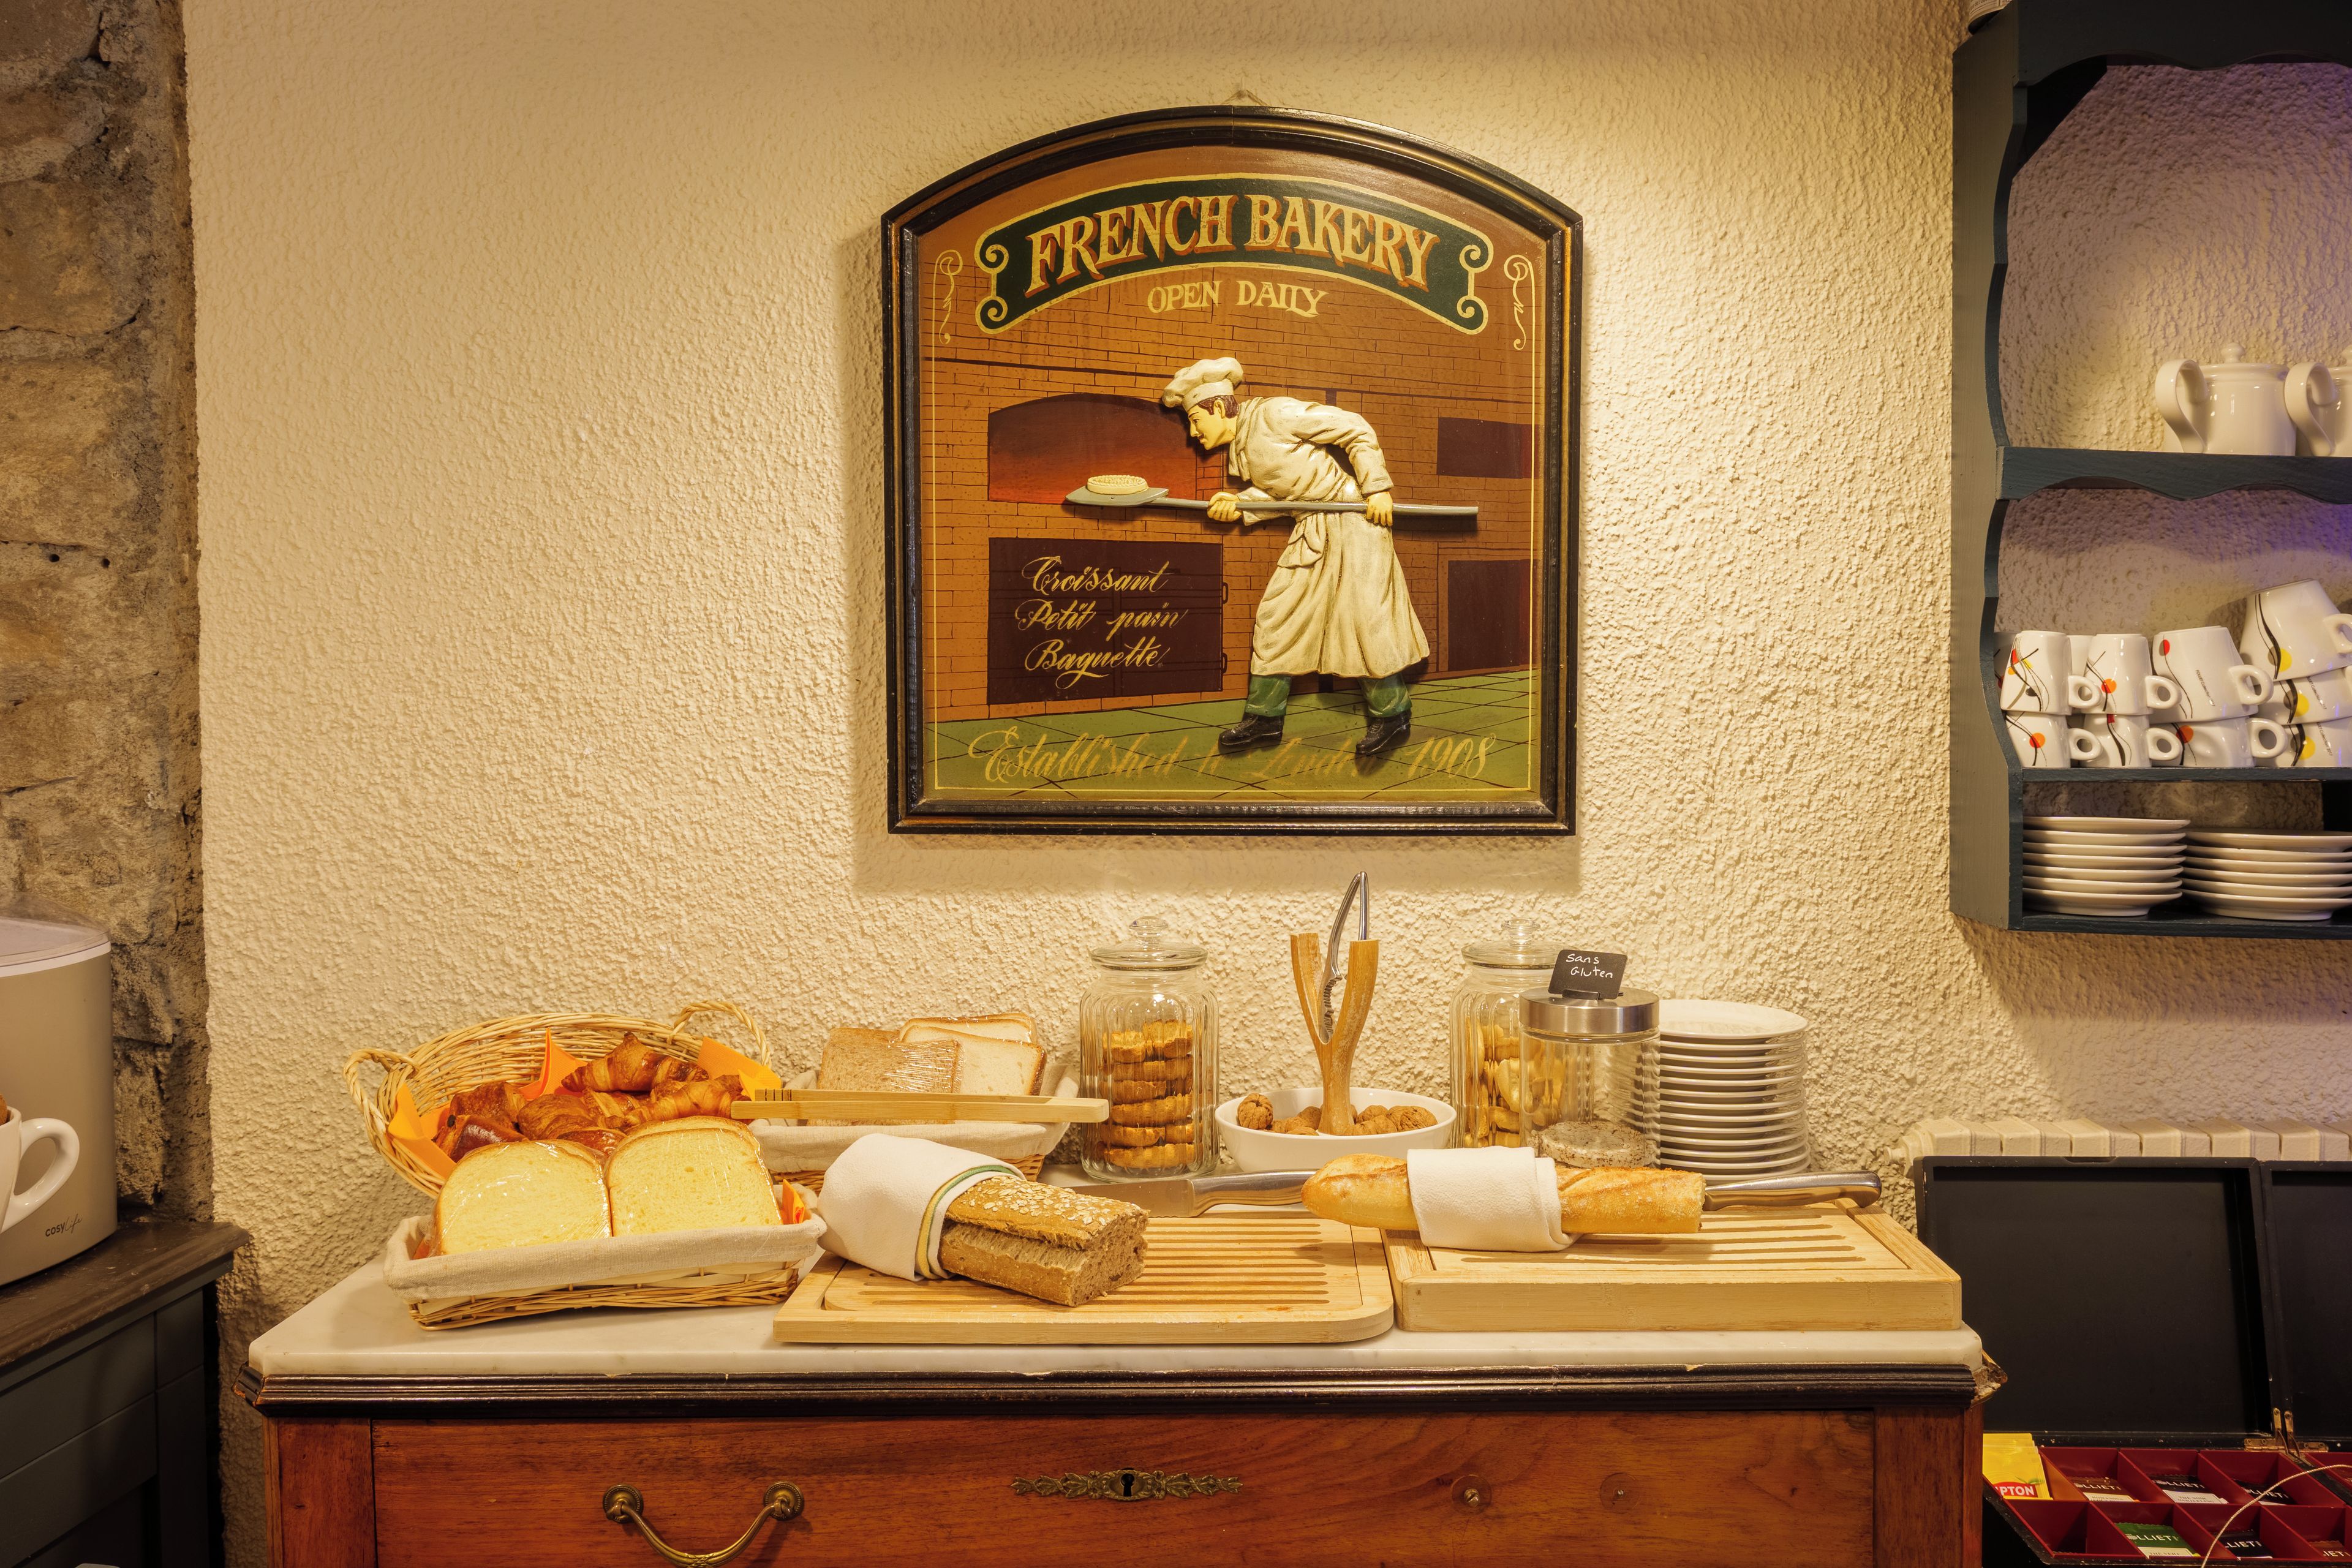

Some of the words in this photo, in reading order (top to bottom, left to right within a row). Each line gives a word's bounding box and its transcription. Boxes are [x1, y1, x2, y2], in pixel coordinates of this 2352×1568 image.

[1025, 195, 1237, 298] FRENCH
[1246, 194, 1441, 293] BAKERY
[1147, 279, 1223, 314] OPEN
[1235, 280, 1329, 317] DAILY
[1022, 556, 1177, 596] Croissant
[1014, 598, 1097, 631] Petit
[1106, 602, 1189, 642] pain
[1025, 636, 1170, 690] Baguette
[968, 725, 1189, 784] Established
[1406, 733, 1496, 779] 1908
[1566, 953, 1600, 965] Sans
[1570, 966, 1613, 979] Gluten
[1995, 1486, 2035, 1496] PTON
